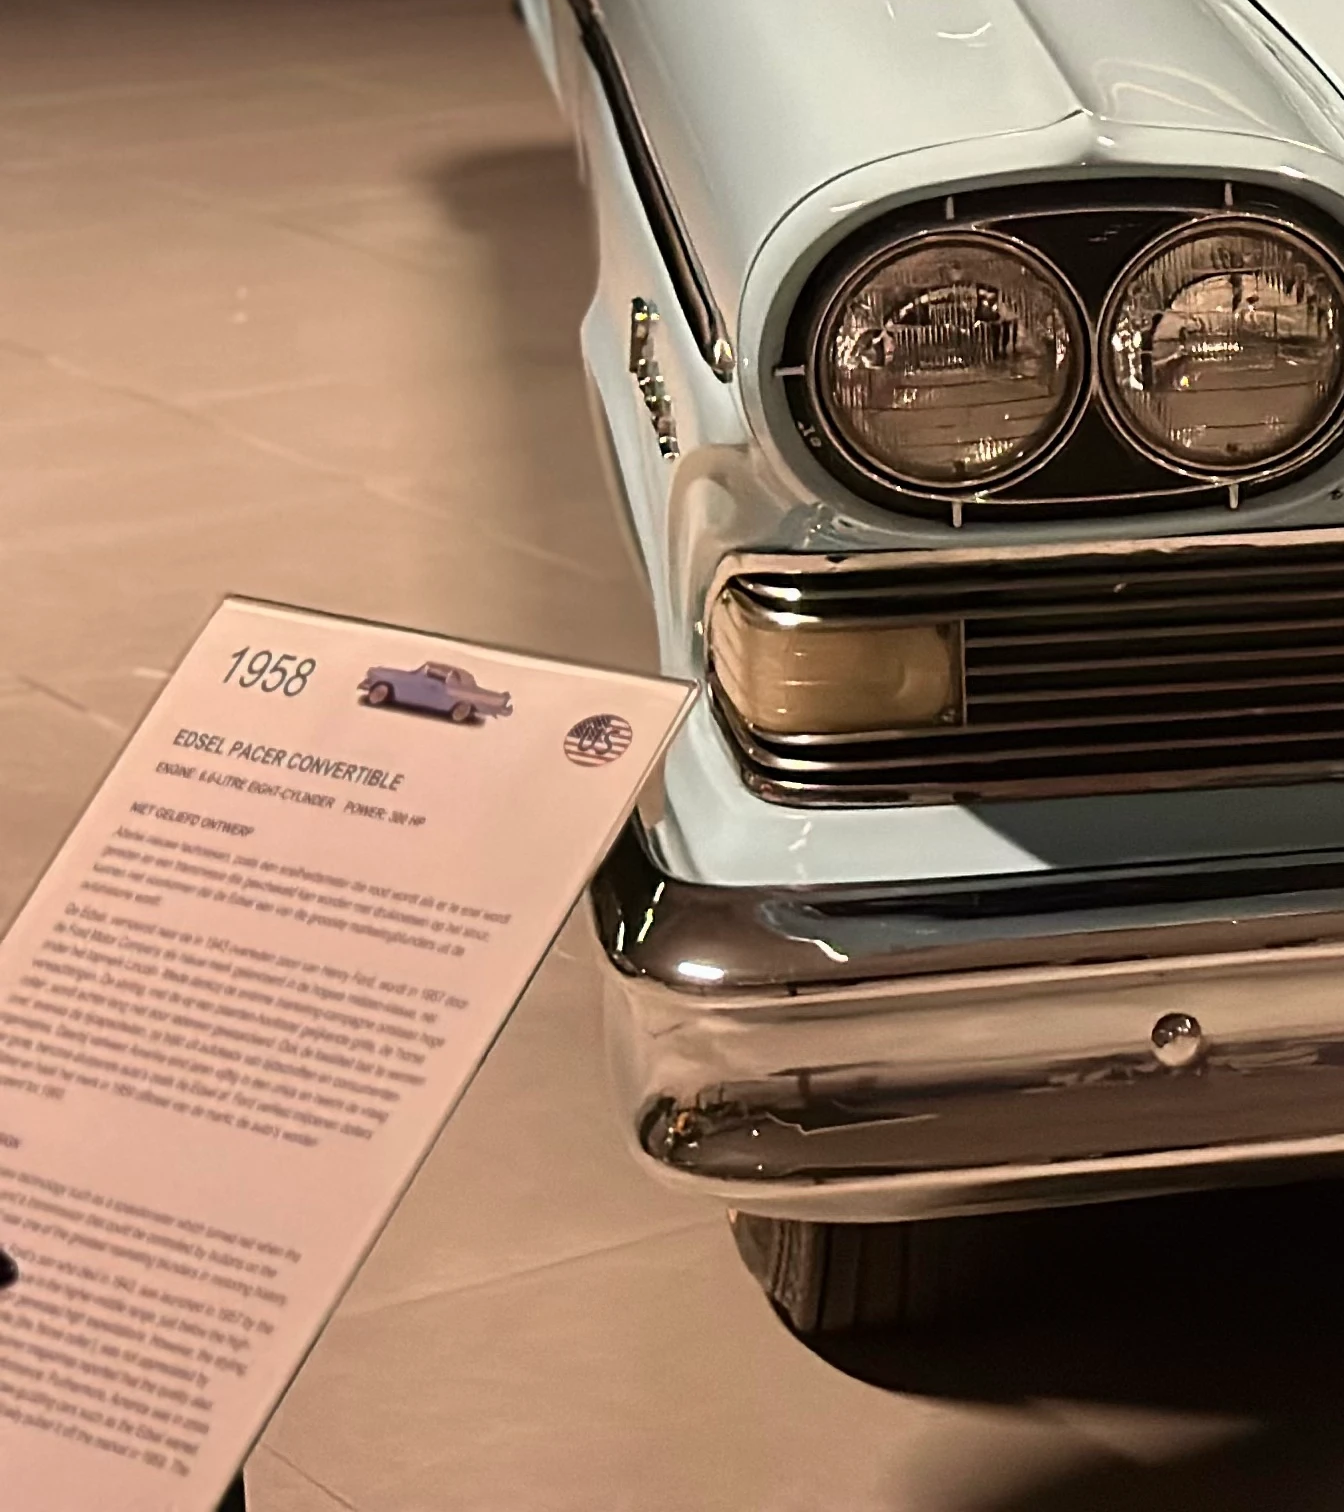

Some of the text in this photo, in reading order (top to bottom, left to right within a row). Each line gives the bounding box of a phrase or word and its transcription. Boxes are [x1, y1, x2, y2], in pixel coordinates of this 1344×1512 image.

[222, 646, 317, 697] 1958
[173, 729, 404, 792] EDSEL PACER CONVERTIBLE
